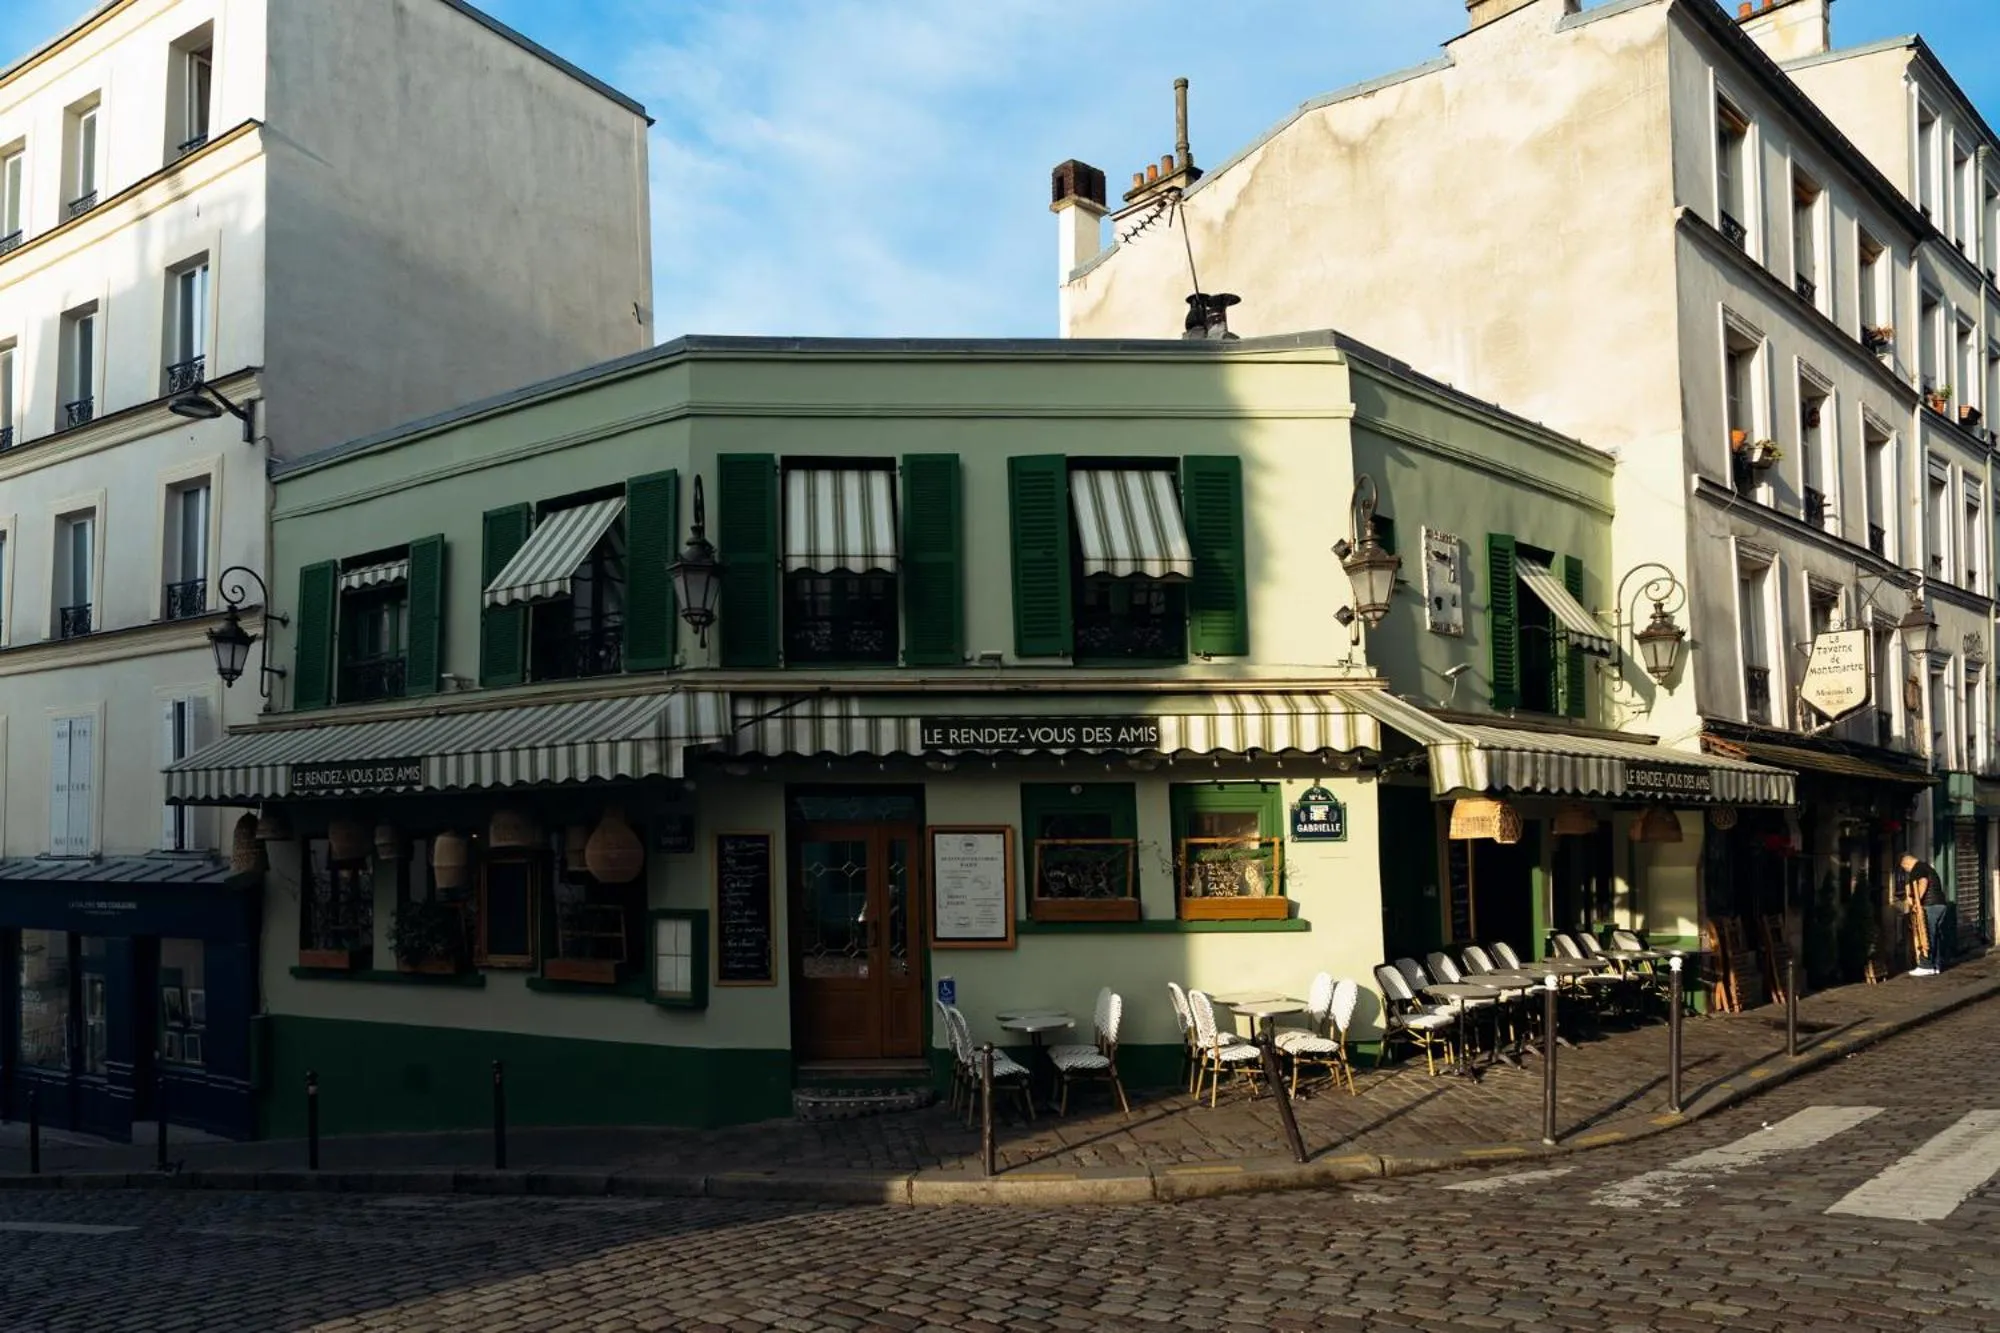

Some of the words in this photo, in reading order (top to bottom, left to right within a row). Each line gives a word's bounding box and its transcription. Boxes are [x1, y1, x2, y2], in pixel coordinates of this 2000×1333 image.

[1829, 635, 1840, 643] La
[1816, 644, 1853, 656] Taverne
[1830, 656, 1841, 664] de
[924, 728, 943, 745] LE
[949, 727, 1077, 744] RENDEZ-VOUS
[1082, 727, 1113, 743] DES
[1118, 726, 1158, 743] AMIS
[292, 771, 304, 786] LE
[305, 768, 374, 786] RENDEZ-VOUS
[376, 767, 395, 782] DES
[396, 765, 420, 781] AMIS
[1626, 769, 1636, 785] LE
[1636, 769, 1683, 789] RENDEZ-VOUS
[1683, 774, 1695, 789] DES
[1696, 775, 1710, 790] AMIS
[1309, 812, 1328, 821] RE
[1296, 822, 1341, 832] GABRIELLE
